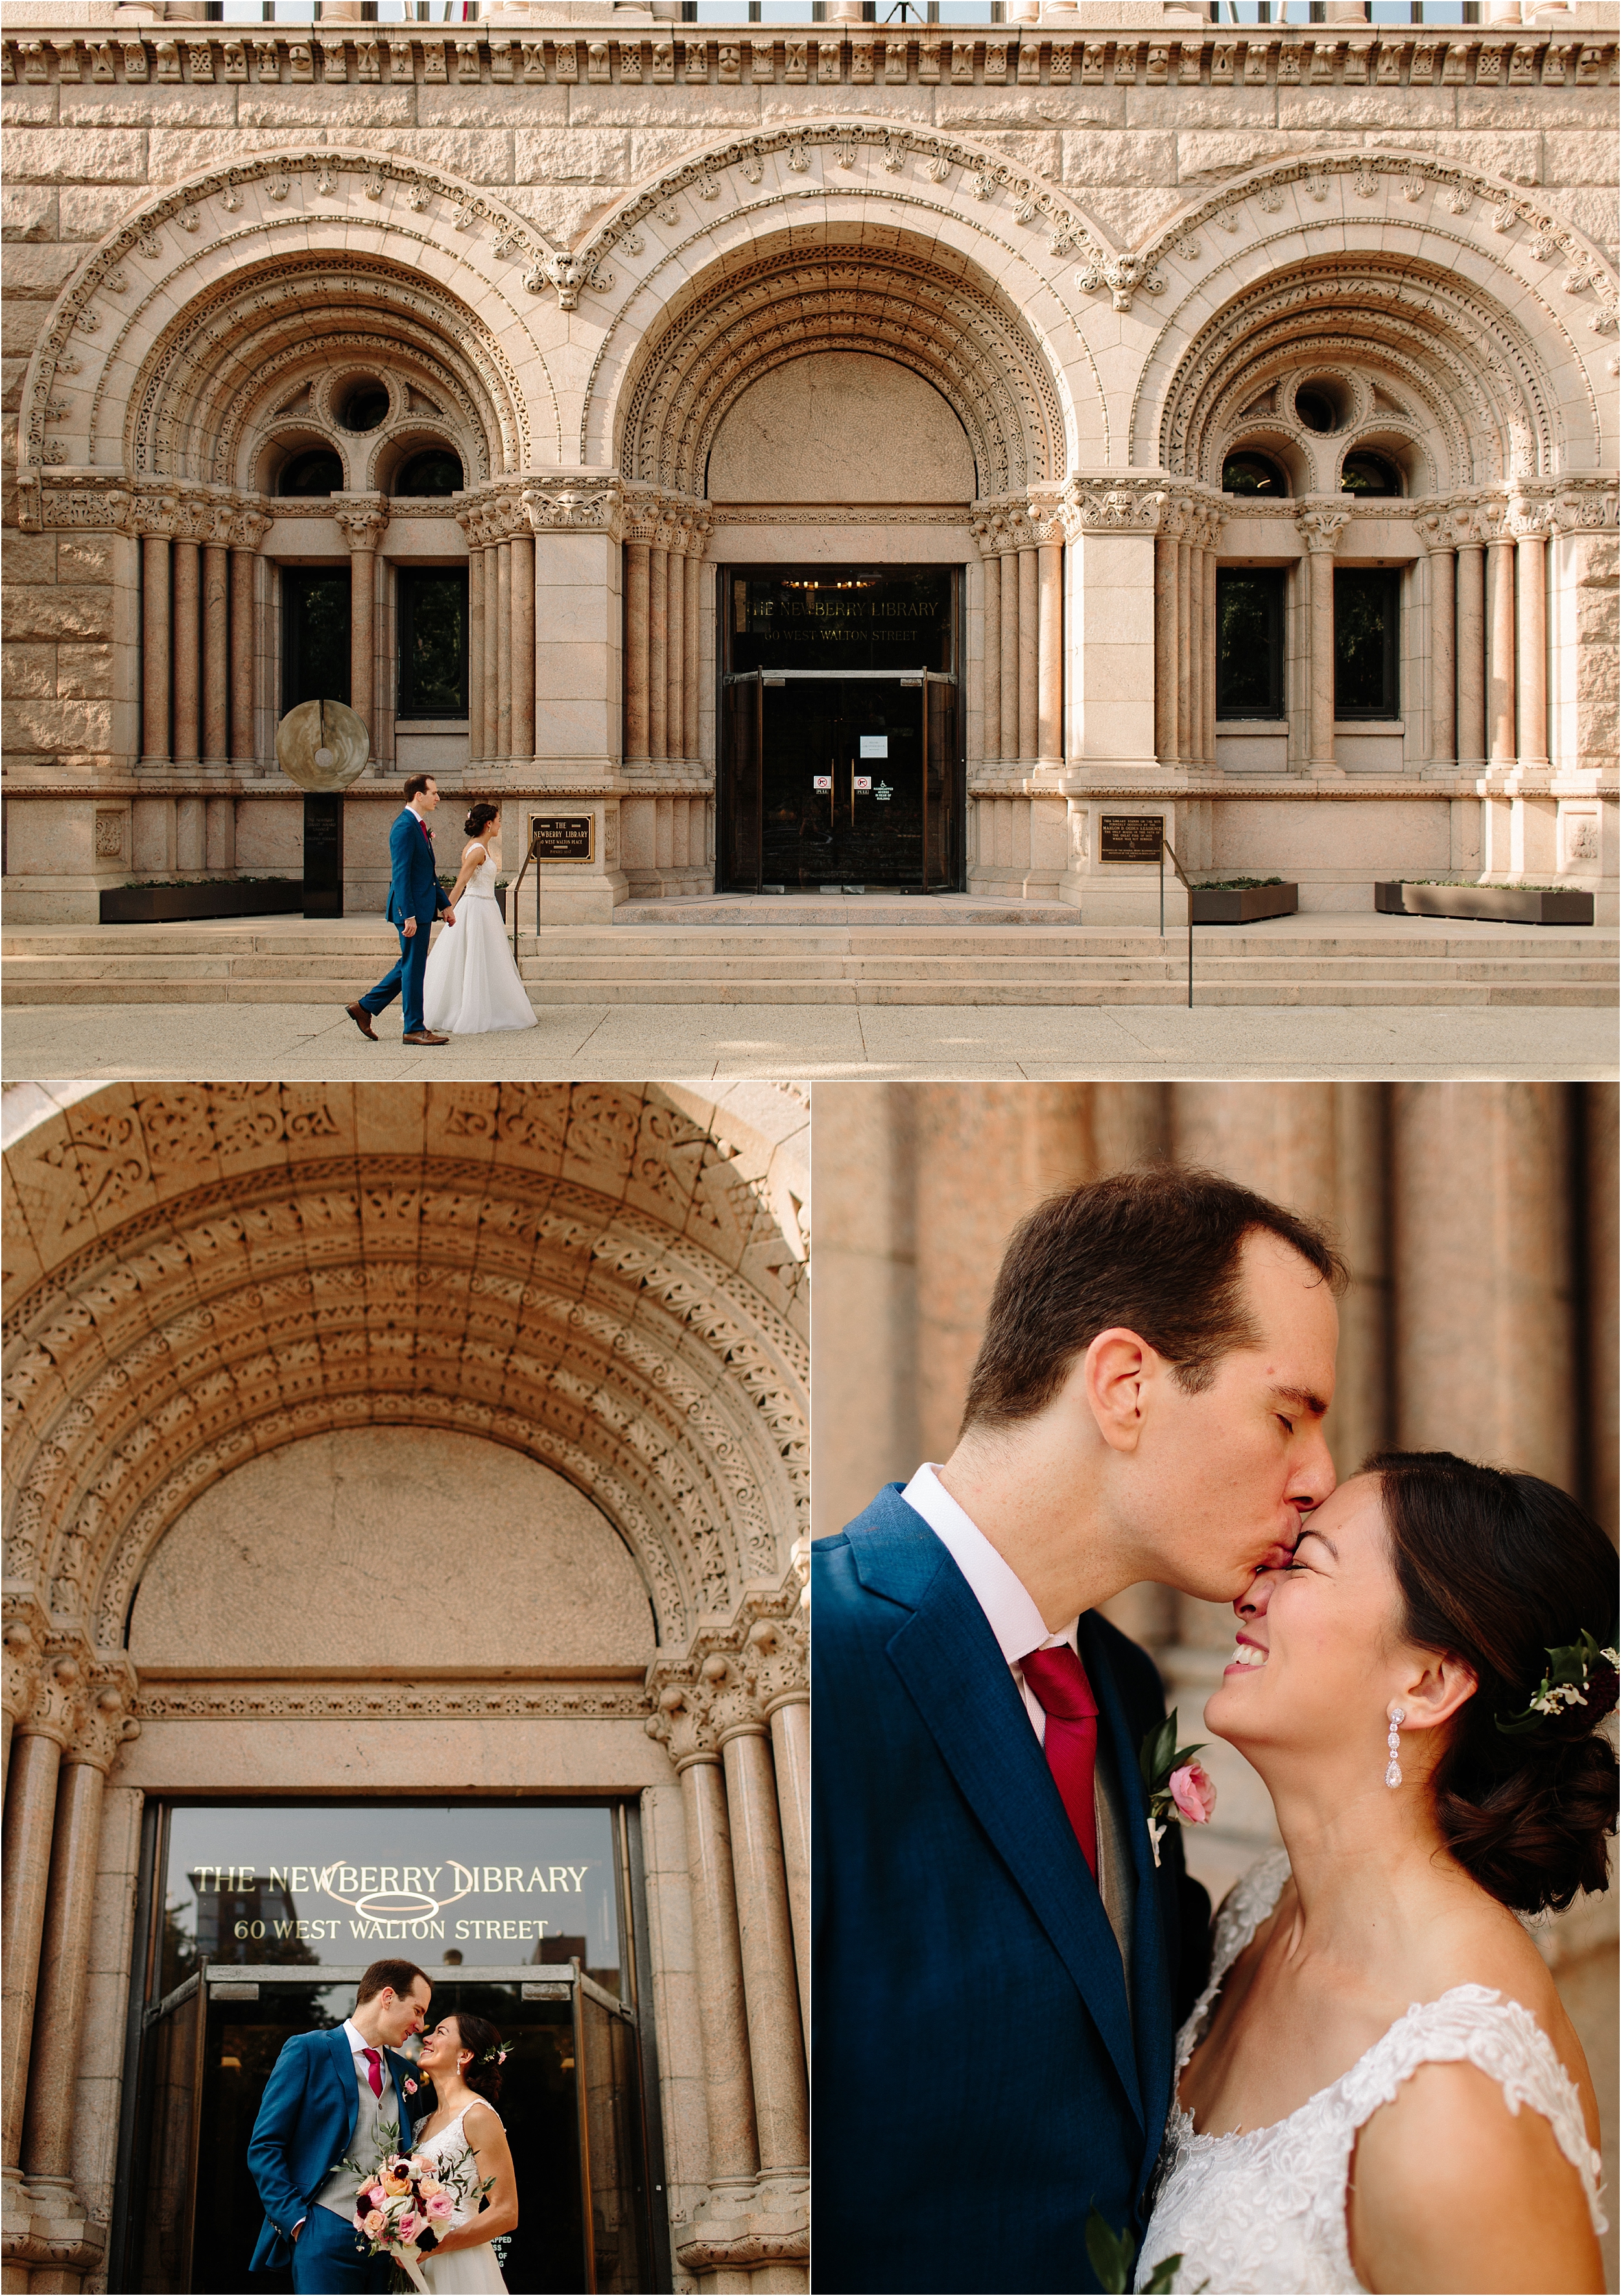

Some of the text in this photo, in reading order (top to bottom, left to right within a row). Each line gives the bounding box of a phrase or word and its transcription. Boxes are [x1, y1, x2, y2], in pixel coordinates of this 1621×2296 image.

[780, 602, 866, 616] NEWBERRY
[871, 602, 939, 616] LIBRARY
[784, 630, 816, 641] WEST
[820, 630, 868, 641] WALTON
[872, 630, 918, 641] STREET
[194, 1867, 588, 1892] THE NEWBERRY LIBRARY
[234, 1920, 549, 1939] 60 WEST WALTON STREET
